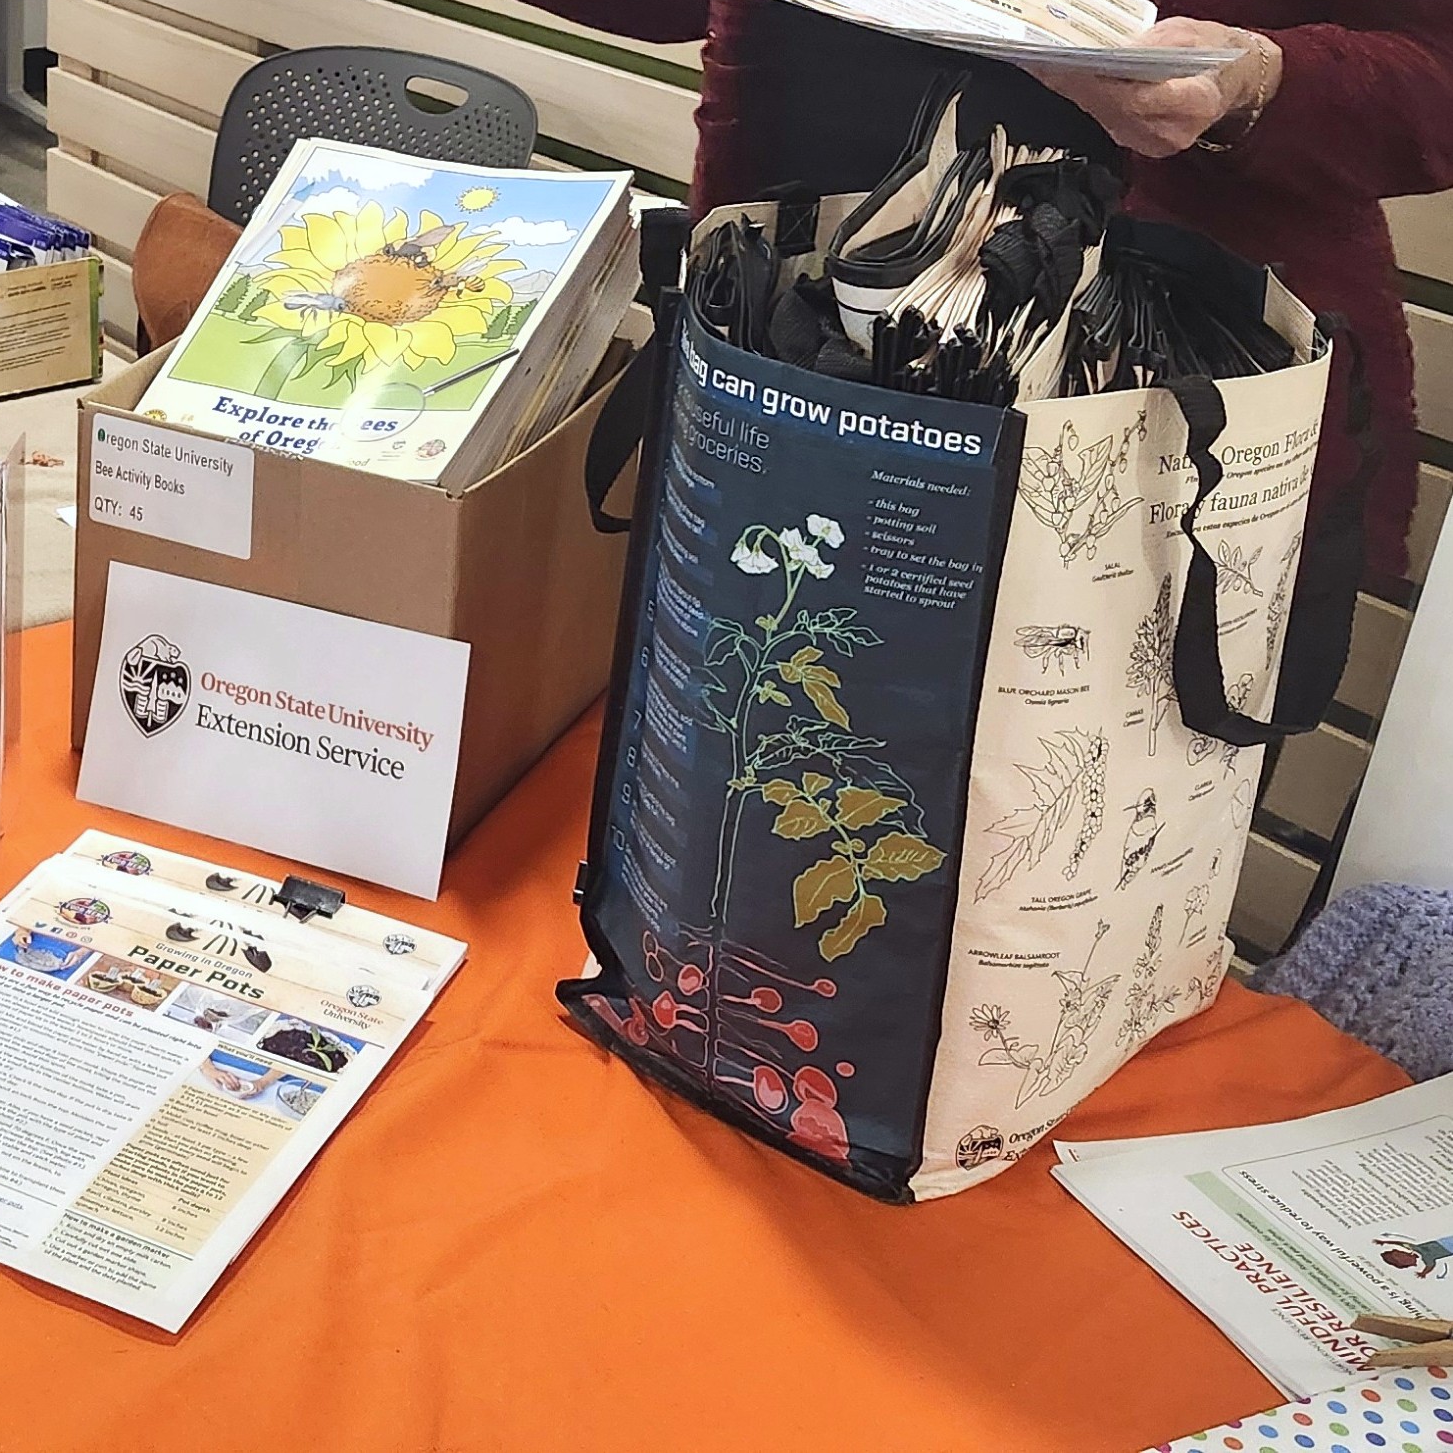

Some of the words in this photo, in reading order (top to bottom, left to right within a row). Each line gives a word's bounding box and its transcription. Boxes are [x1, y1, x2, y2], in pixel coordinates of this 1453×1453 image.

[212, 396, 303, 430] Explore
[354, 417, 398, 433] ees
[712, 369, 755, 402] can
[762, 388, 831, 424] grow
[838, 409, 982, 456] potatoes
[238, 430, 264, 444] of
[740, 421, 770, 450] life
[97, 428, 139, 452] Oregon
[142, 438, 172, 459] State
[174, 446, 234, 477] University
[1221, 445, 1279, 465] Oregon
[95, 460, 113, 478] Bee
[115, 467, 151, 490] Activity
[154, 474, 185, 496] Books
[871, 470, 925, 489] Materials
[927, 484, 971, 496] needed:
[94, 496, 122, 517] QTY:
[129, 505, 143, 522] 45
[875, 499, 896, 511] this
[898, 502, 920, 517] bag
[1148, 501, 1190, 524] Flora
[1210, 492, 1258, 512] fauna
[1261, 477, 1298, 503] nativa
[872, 531, 915, 545] scissors
[873, 516, 914, 532] potting
[916, 524, 937, 534] soil
[870, 546, 894, 558] tray
[896, 550, 908, 560] to
[910, 554, 926, 564] set
[928, 556, 946, 567] the
[948, 558, 969, 572] bag
[972, 563, 983, 573] in
[865, 574, 912, 591] potatoes
[914, 584, 937, 595] that
[939, 587, 966, 599] have
[876, 566, 889, 574] or
[890, 568, 898, 576] 2
[900, 570, 947, 585] certified
[948, 580, 974, 589] seed
[864, 586, 904, 600] started
[906, 591, 916, 603] to
[918, 597, 956, 609] sprout
[1056, 686, 1079, 696] MASON
[200, 672, 272, 706] Oregon
[274, 690, 325, 720] State
[328, 703, 435, 752] University
[195, 703, 310, 756] Extension
[316, 736, 405, 780] Service
[155, 942, 199, 965] Growing
[201, 955, 212, 965] in
[213, 959, 253, 979] Oregon
[968, 948, 1013, 961] ARROWLEAF
[1014, 951, 1060, 960] BALSAMROOT
[127, 944, 202, 977] Paper
[205, 969, 265, 1000] Pots
[9, 967, 24, 979] to
[29, 971, 62, 992] make
[62, 986, 101, 1006] paper
[102, 1000, 135, 1017] pots
[320, 999, 356, 1018] Oregon
[358, 1012, 384, 1025] State
[322, 1008, 371, 1029] University
[1239, 1170, 1268, 1194] stress
[1267, 1194, 1303, 1223] reduce
[1299, 1218, 1313, 1232] to
[1312, 1228, 1334, 1247] way
[1171, 1210, 1279, 1295] PRACTICES
[1335, 1247, 1380, 1286] powerful
[1236, 1241, 1349, 1331] RESILIENCE
[1388, 1290, 1401, 1303] is
[1275, 1295, 1376, 1372] MINDFUL
[1345, 1334, 1379, 1358] OR
